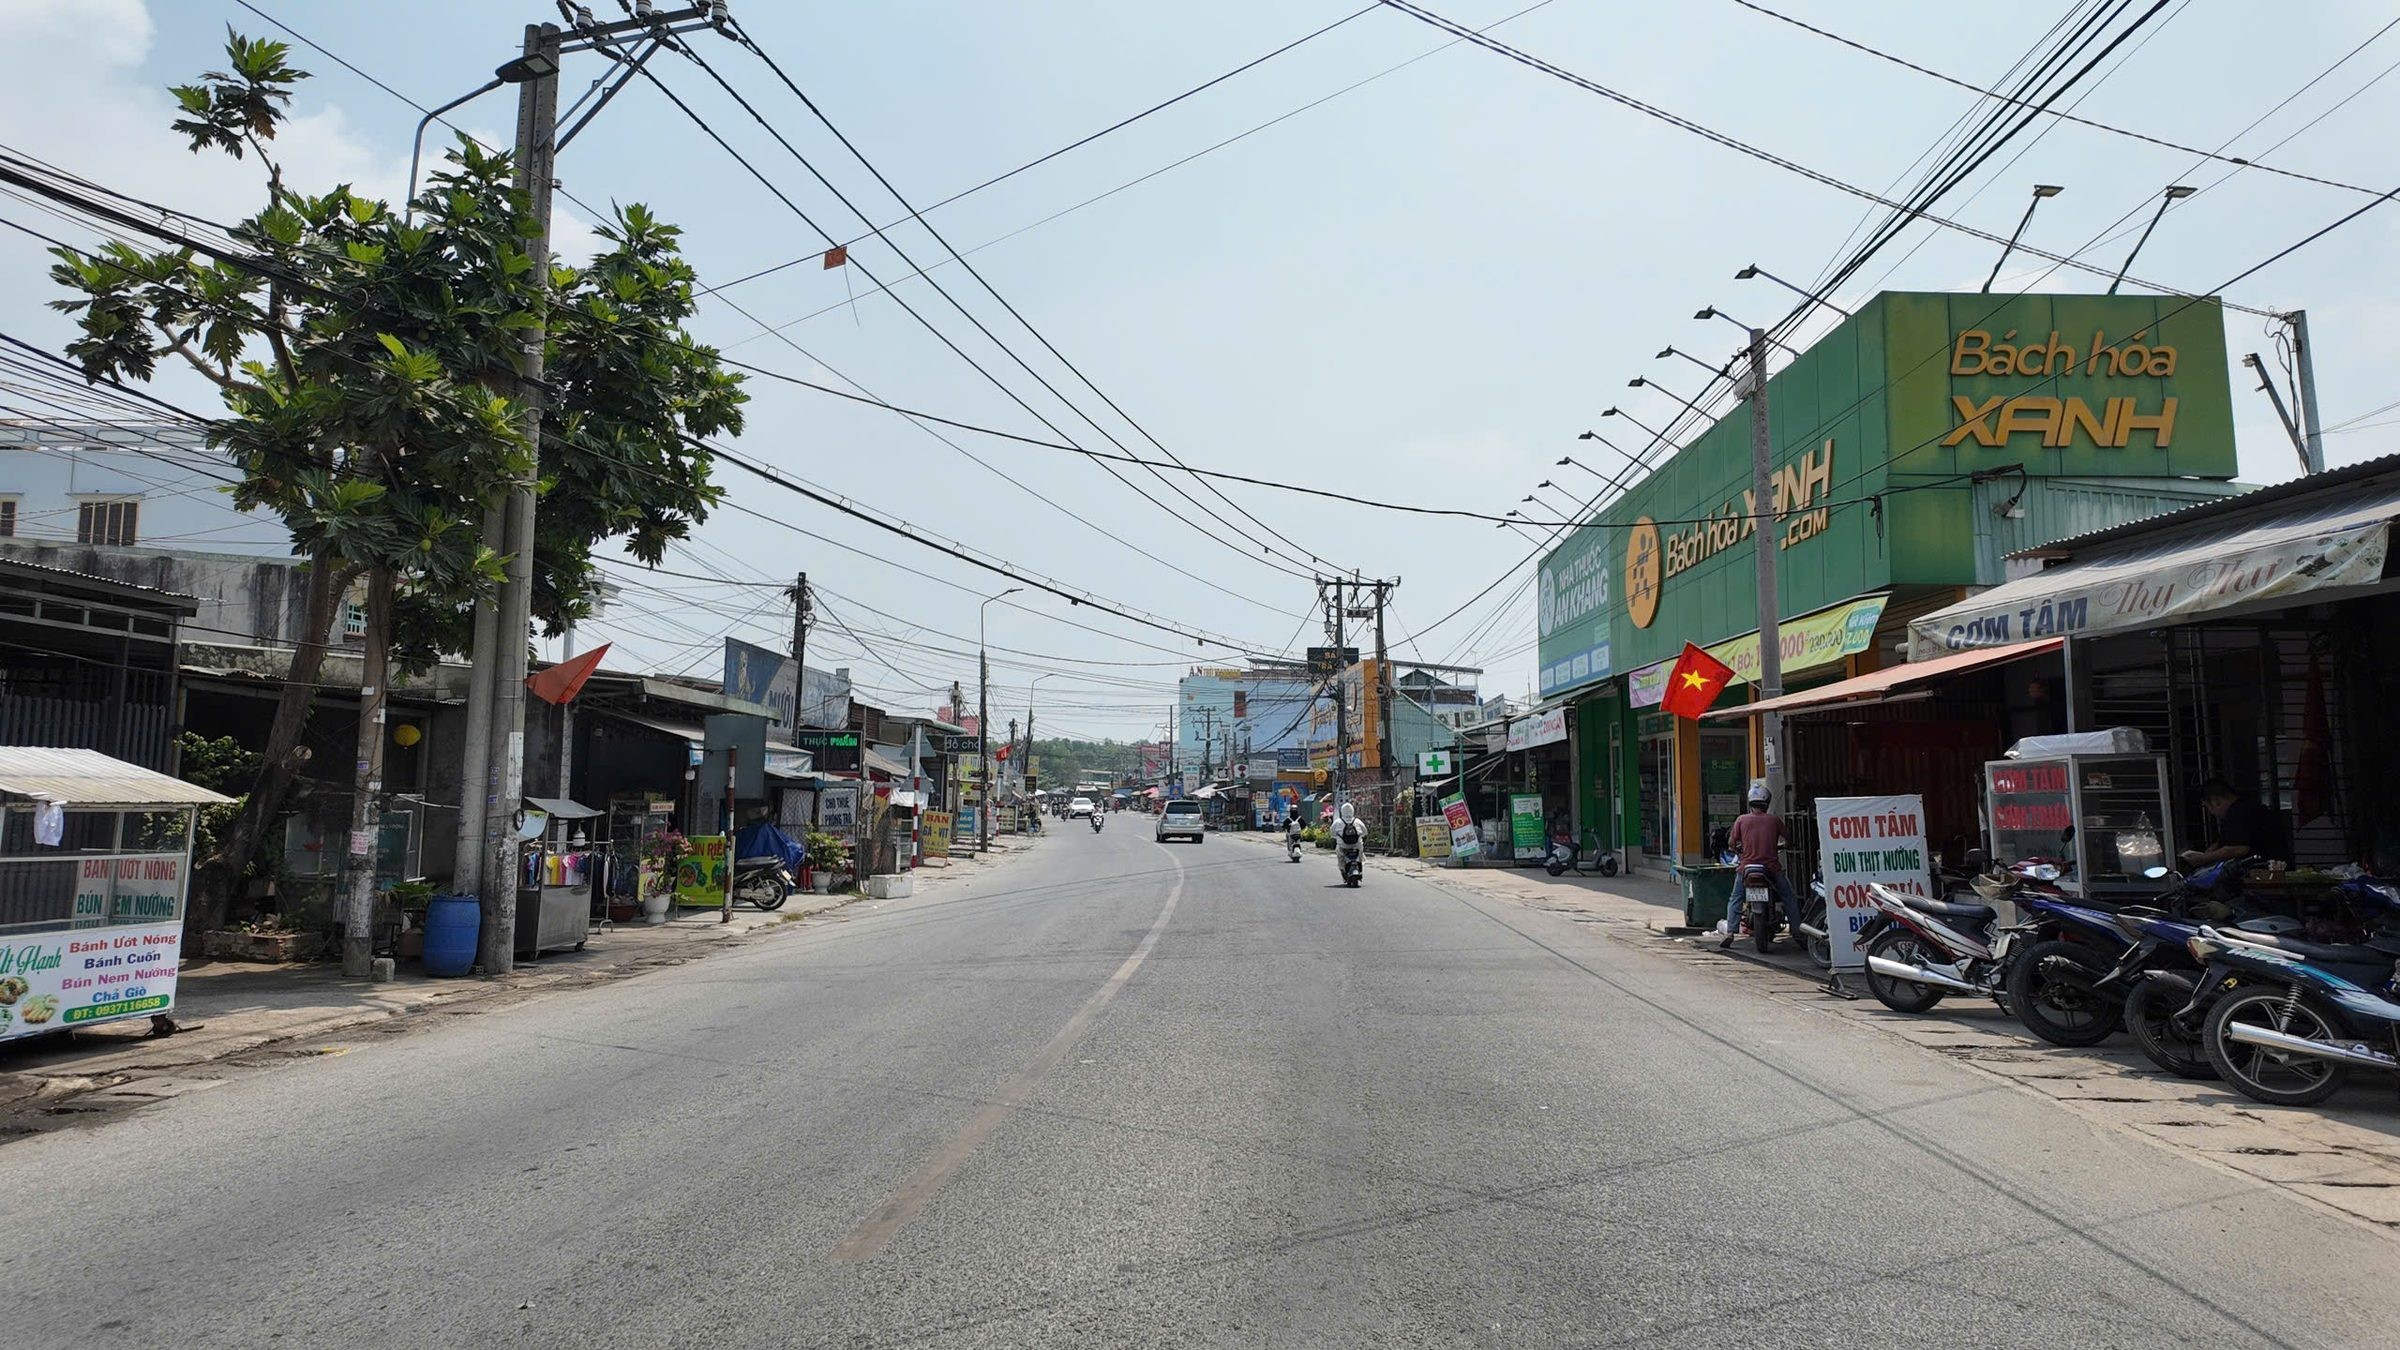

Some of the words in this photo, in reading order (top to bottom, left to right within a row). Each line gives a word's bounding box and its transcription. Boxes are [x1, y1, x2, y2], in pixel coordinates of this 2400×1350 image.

[1950, 329, 2076, 377] Bách
[2086, 329, 2178, 377] hóa
[1939, 395, 2178, 447] XANH
[1665, 520, 1705, 578] Bách
[1705, 499, 1740, 557] hóa
[1558, 559, 1574, 592] NHÀ
[1554, 592, 1570, 630] AN
[1570, 567, 1609, 621] KHANG
[1946, 614, 2010, 651] CƠM
[803, 737, 828, 747] THỰC
[1829, 816, 1872, 840] CƠM
[1875, 806, 1919, 838] TẤM
[1833, 848, 1857, 873] BÚN
[1858, 850, 1880, 876] THỊT
[1883, 846, 1921, 871] NƯỚNG
[76, 890, 103, 914] BÚN
[113, 894, 131, 915] EM
[134, 892, 175, 917] NƯỚNG
[1833, 880, 1871, 909] CƠM
[69, 939, 108, 953] Bánh
[113, 935, 138, 949] Ướt
[142, 934, 178, 946] Nóng
[16, 945, 62, 976] Hạnh
[84, 954, 122, 969] Bánh
[126, 950, 161, 964] Cuốn
[61, 976, 92, 990] Bún
[97, 971, 129, 985] Nem
[134, 966, 177, 980] Nướng
[73, 1008, 93, 1020] ĐT:
[95, 997, 161, 1015] 0937116658
[92, 988, 120, 1003] Chả
[124, 986, 147, 998] Giò
